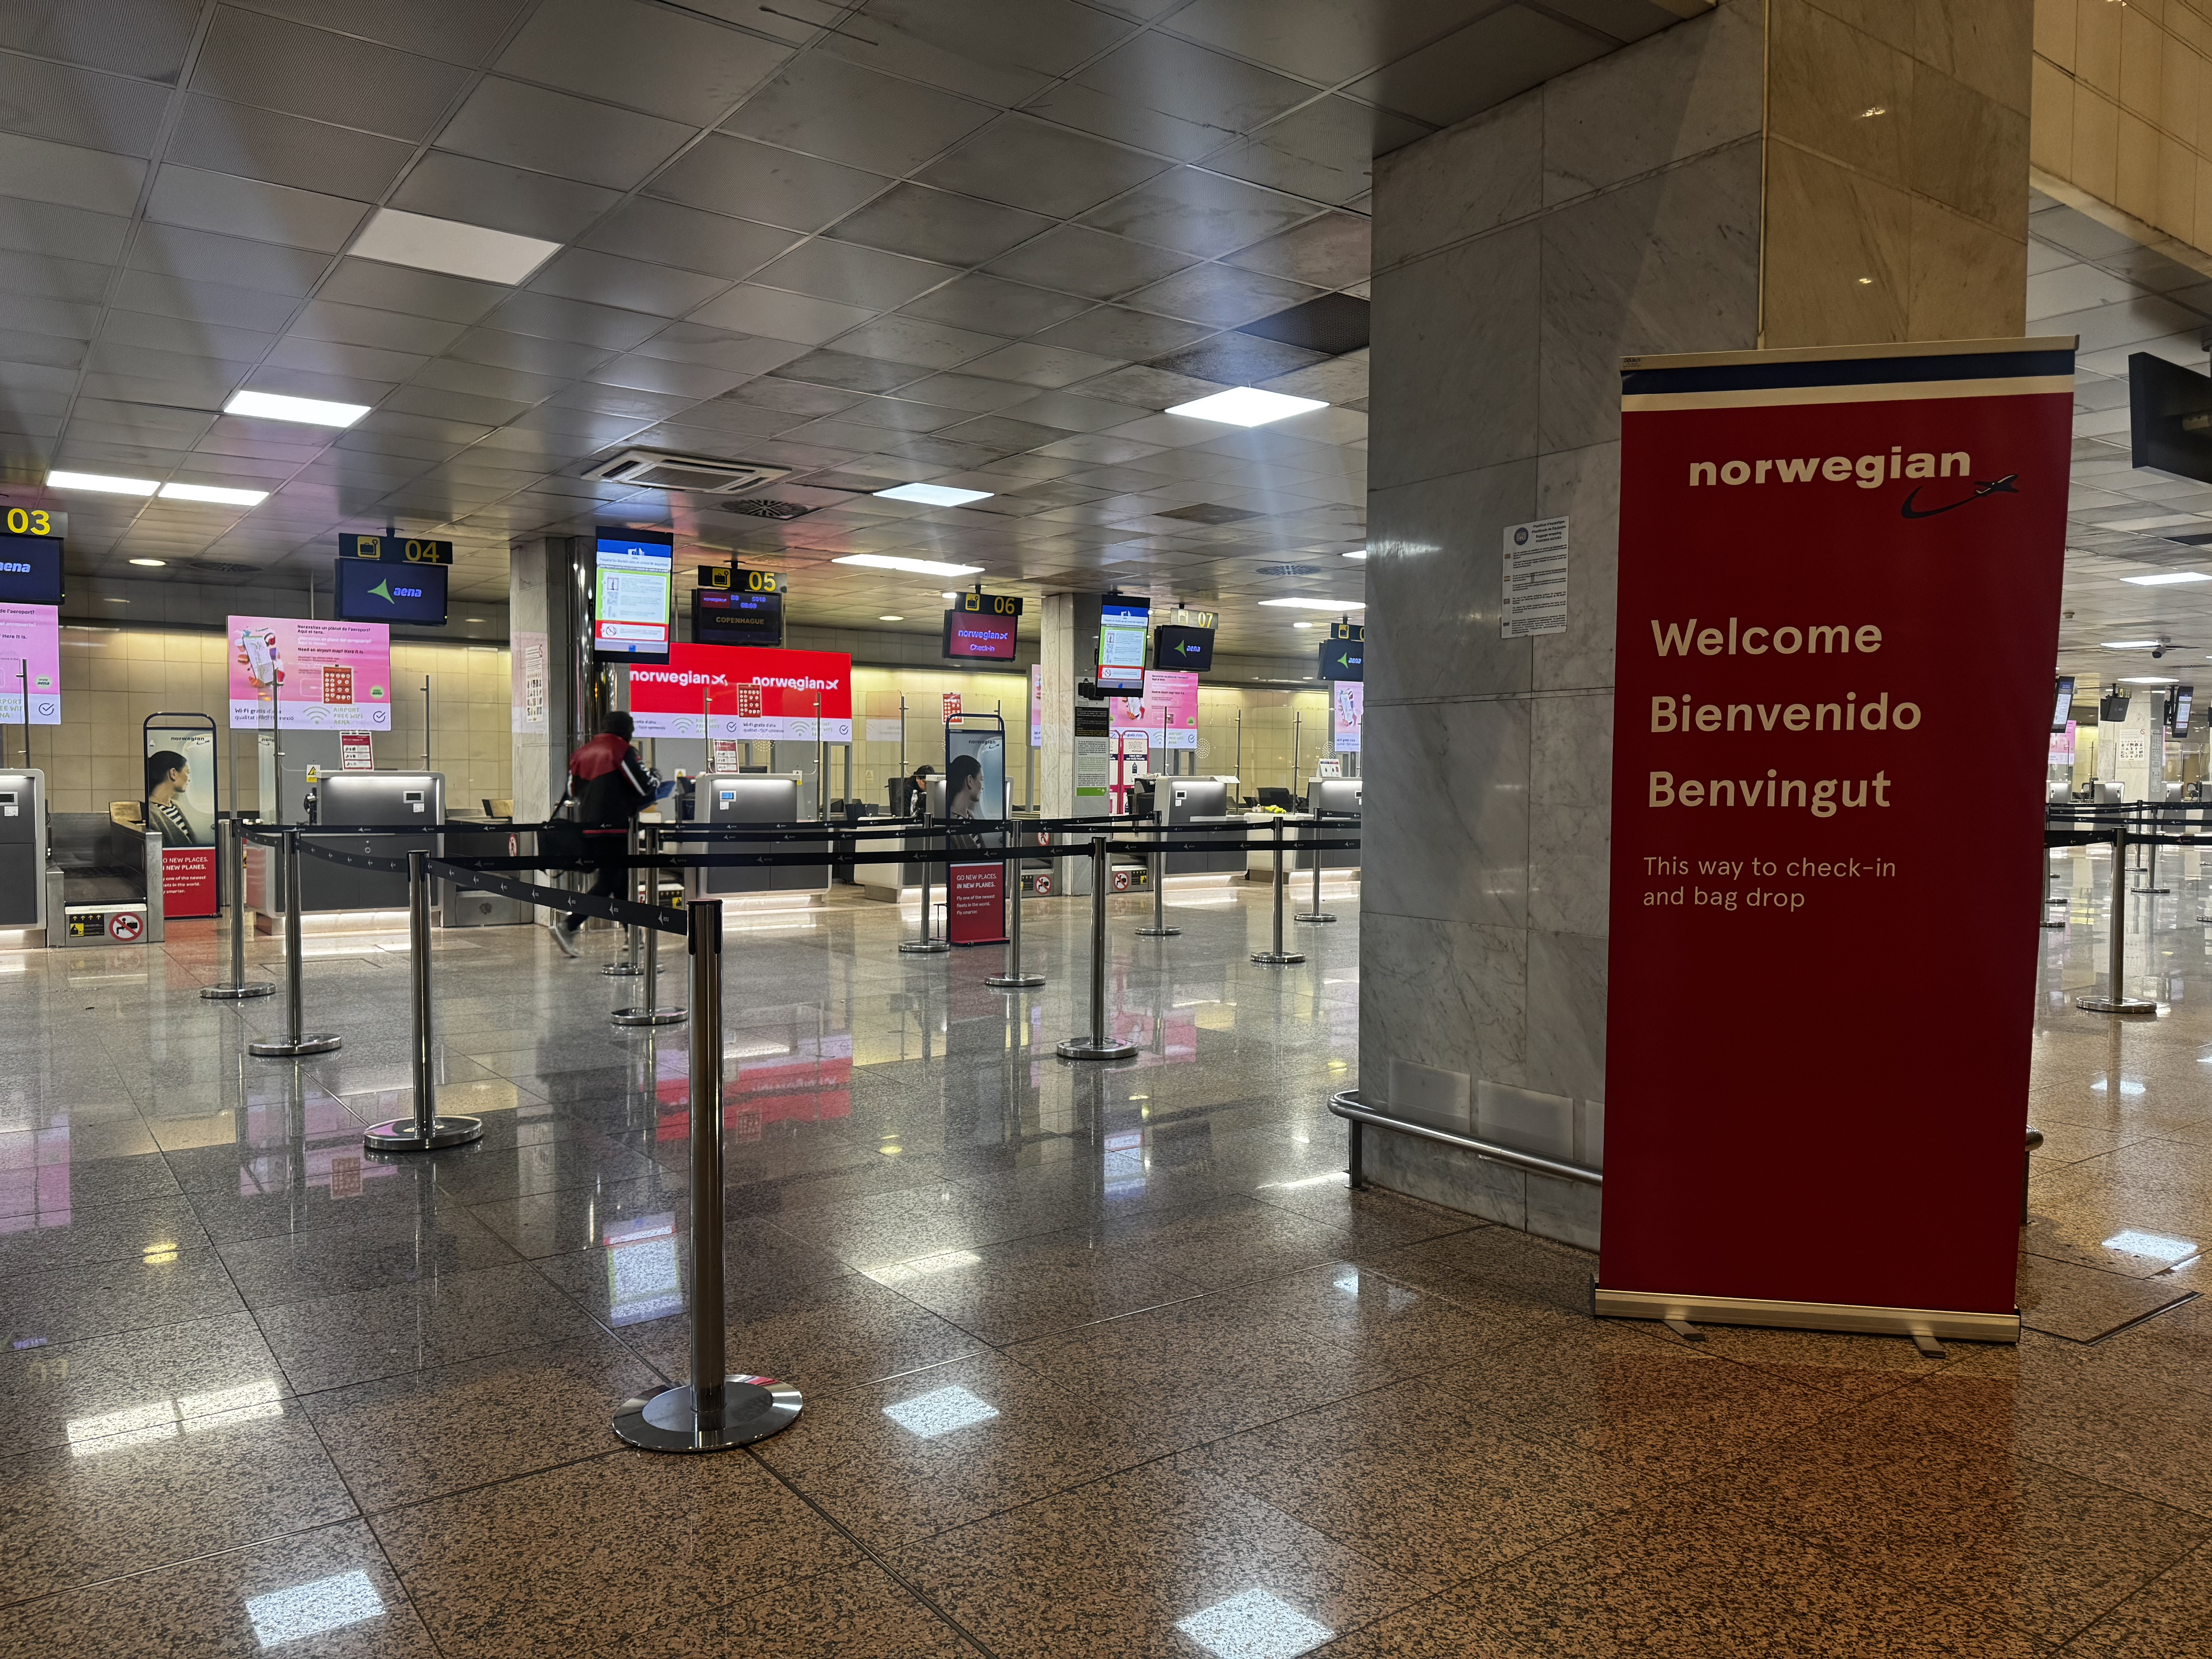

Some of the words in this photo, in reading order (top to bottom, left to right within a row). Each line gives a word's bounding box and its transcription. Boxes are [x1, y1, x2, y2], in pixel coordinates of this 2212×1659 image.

[1690, 446, 1970, 489] norwegian
[7, 508, 51, 535] 03
[405, 540, 440, 563] 04
[393, 587, 422, 597] aena
[749, 571, 776, 592] 05
[994, 597, 1015, 614] 06
[1198, 611, 1213, 628] 07
[958, 630, 1000, 640] norwegian
[1651, 617, 1882, 656] Welcome
[630, 670, 709, 686] norwegian
[752, 676, 824, 691] norwegian
[1651, 692, 1921, 733] Bienvenido
[1649, 769, 1891, 817] Benvingut
[1644, 856, 1688, 876] This
[1698, 861, 1743, 880] way
[1752, 857, 1777, 876] to
[1787, 857, 1896, 877] check-in
[1644, 886, 1684, 906] and
[1695, 886, 1738, 911] bag
[1747, 887, 1805, 912] drop
